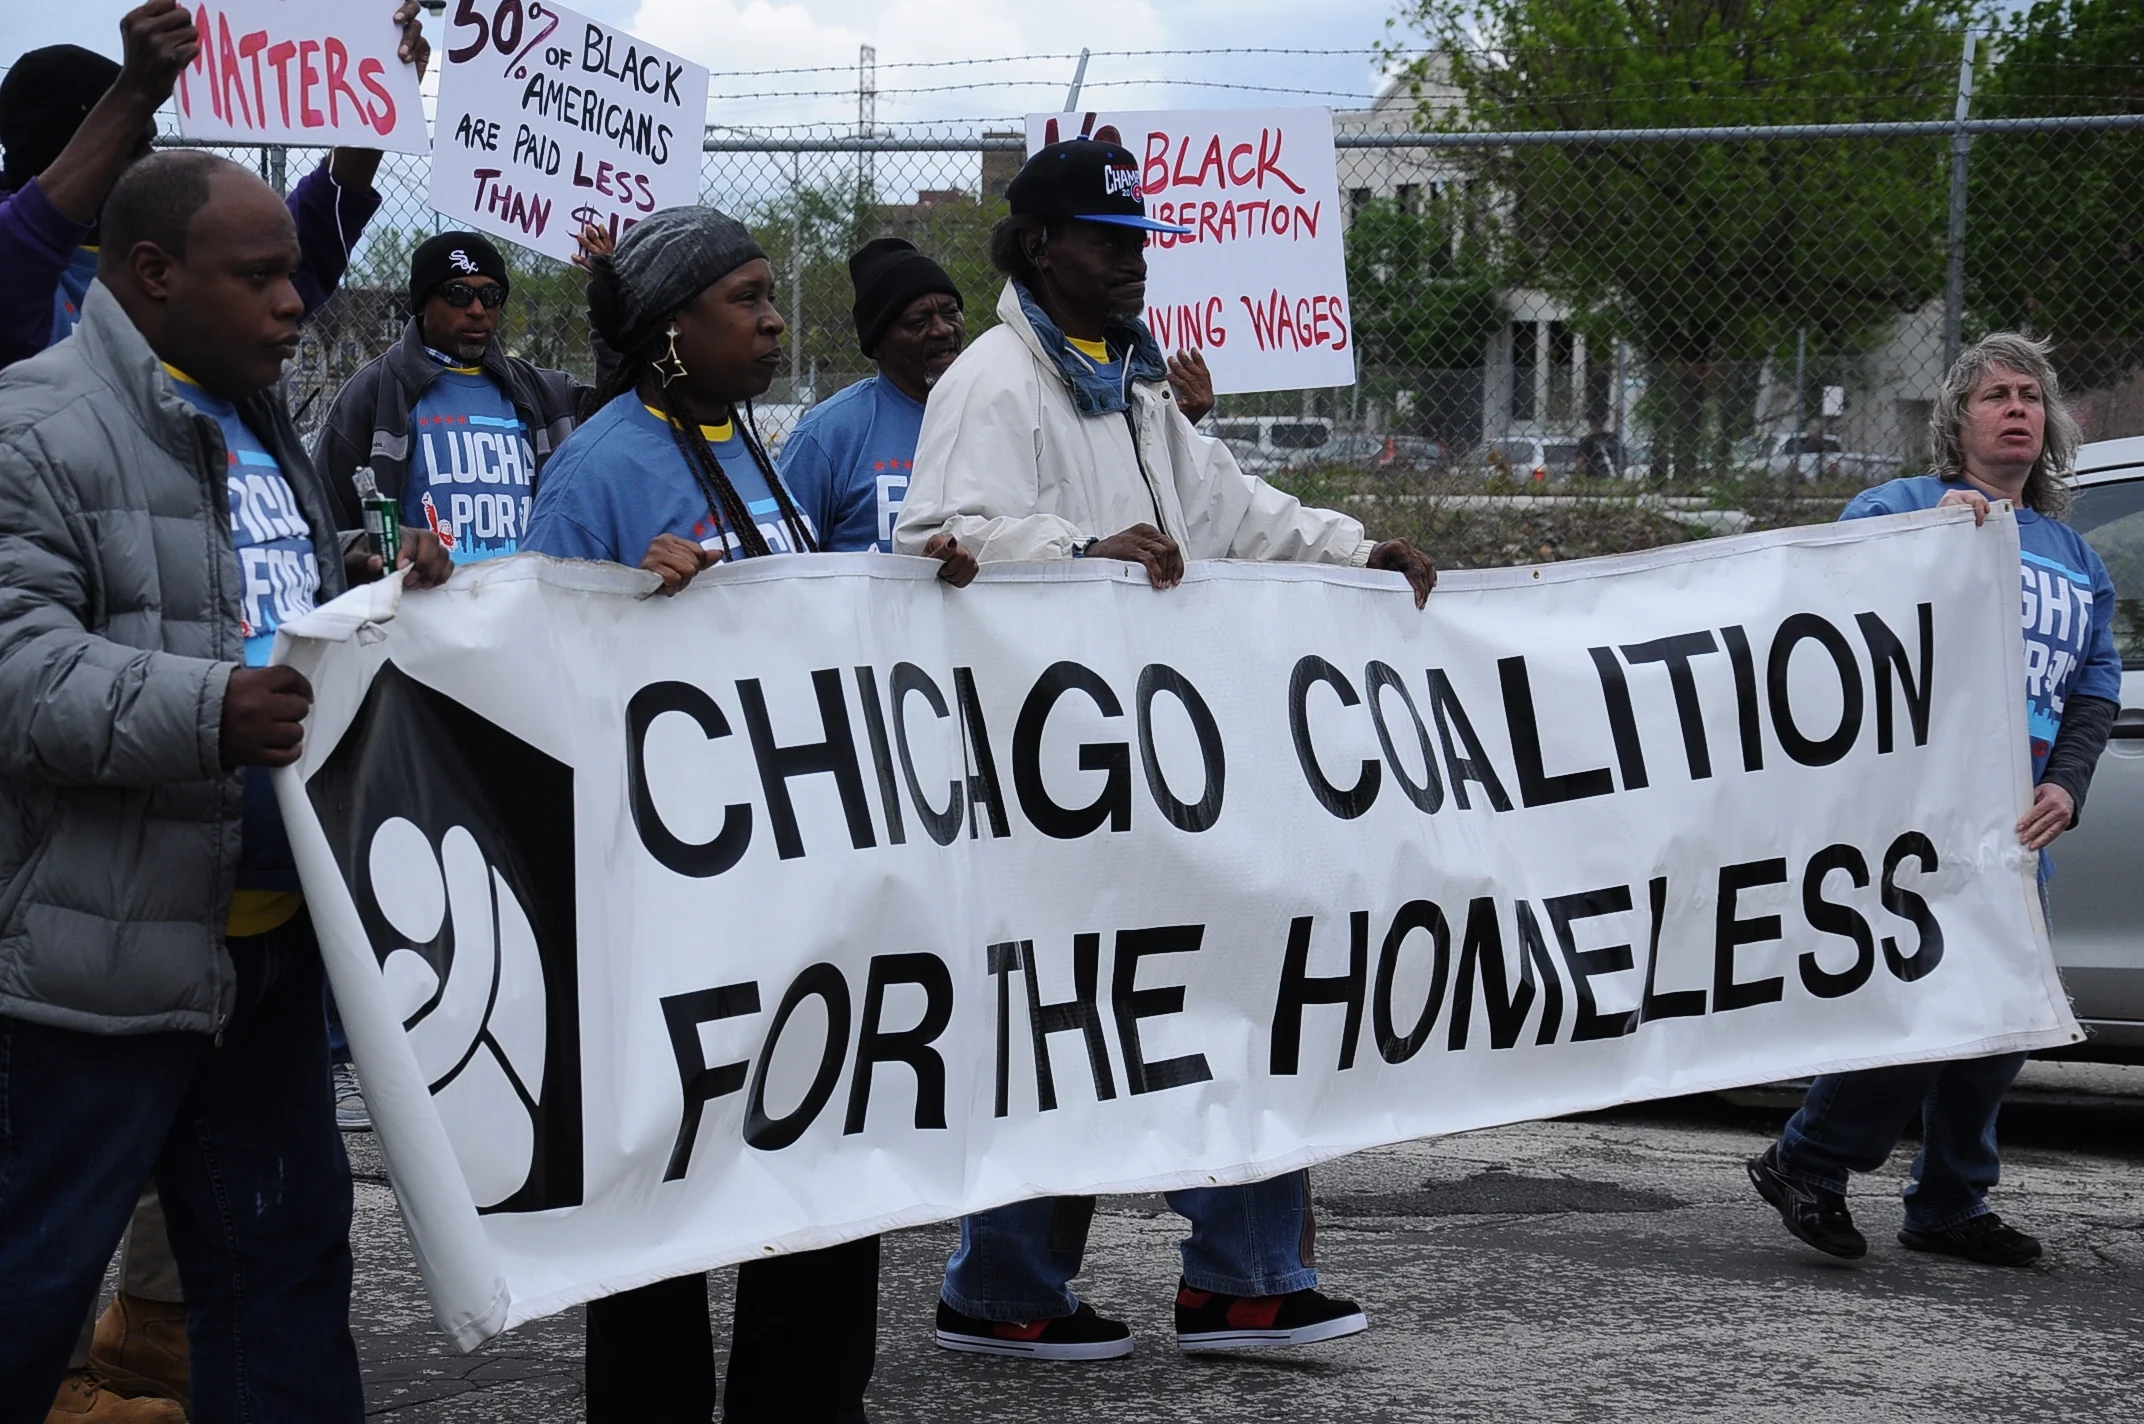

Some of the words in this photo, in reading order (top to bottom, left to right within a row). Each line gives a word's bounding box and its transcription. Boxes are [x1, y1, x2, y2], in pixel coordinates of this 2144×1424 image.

[176, 3, 397, 136] MATTERS
[545, 47, 573, 71] OF
[581, 23, 684, 107] BLACK
[522, 73, 674, 165] AMERICANS
[454, 113, 501, 151] ARE
[513, 123, 561, 175] PAID
[572, 151, 656, 212] LESS
[1142, 127, 1306, 195] BLACK
[473, 168, 552, 238] THAN
[1143, 199, 1321, 249] IBERATION
[1148, 296, 1226, 352] IVING
[1240, 288, 1348, 352] WAGES
[422, 431, 536, 486] LUCHA
[451, 494, 517, 538] POR
[625, 660, 1225, 878] CHICAGO
[1288, 602, 1933, 820] COALITION
[659, 951, 954, 1183] FOR
[986, 923, 1213, 1118] THE
[1269, 831, 1944, 1076] HOMELESS
